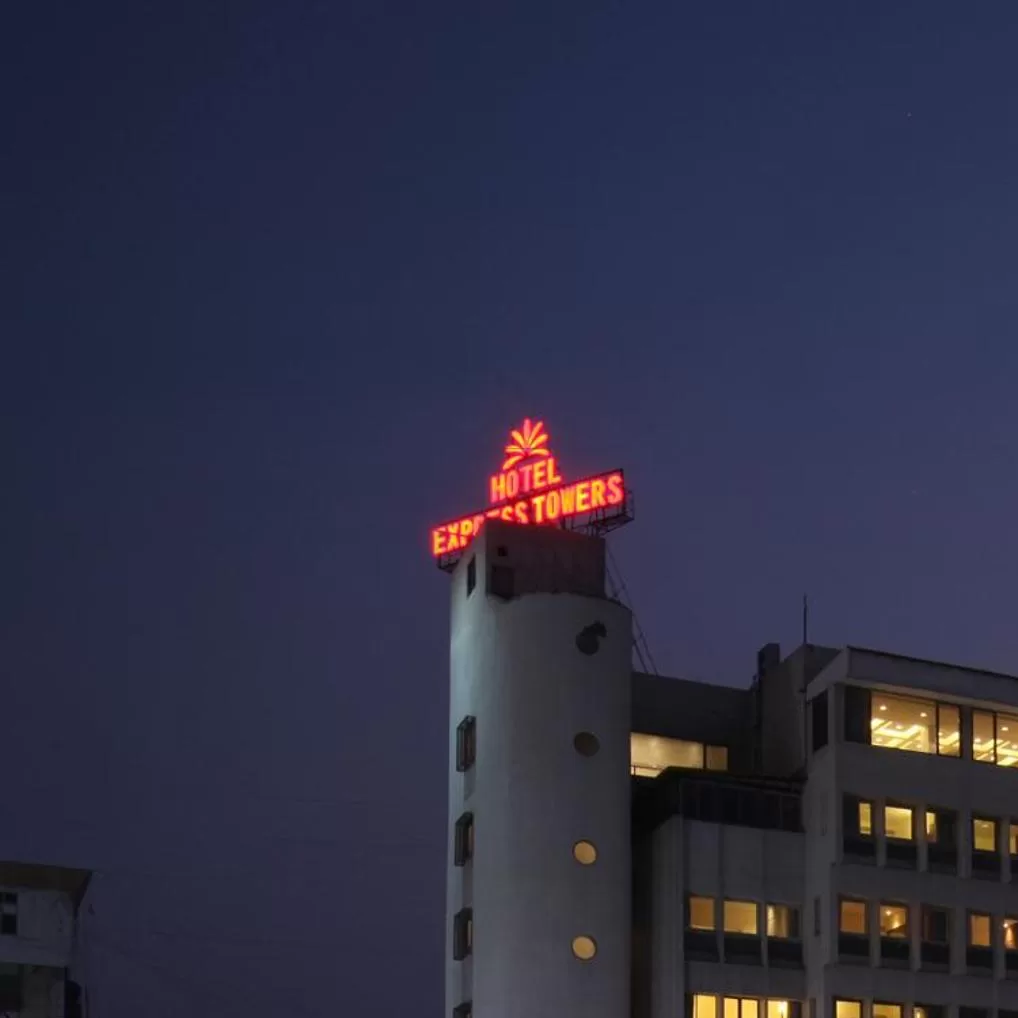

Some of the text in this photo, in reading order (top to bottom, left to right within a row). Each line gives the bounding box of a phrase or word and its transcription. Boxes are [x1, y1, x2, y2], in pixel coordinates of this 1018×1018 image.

[490, 457, 561, 503] HOTEL
[432, 473, 624, 555] EXPSS TOWERS
